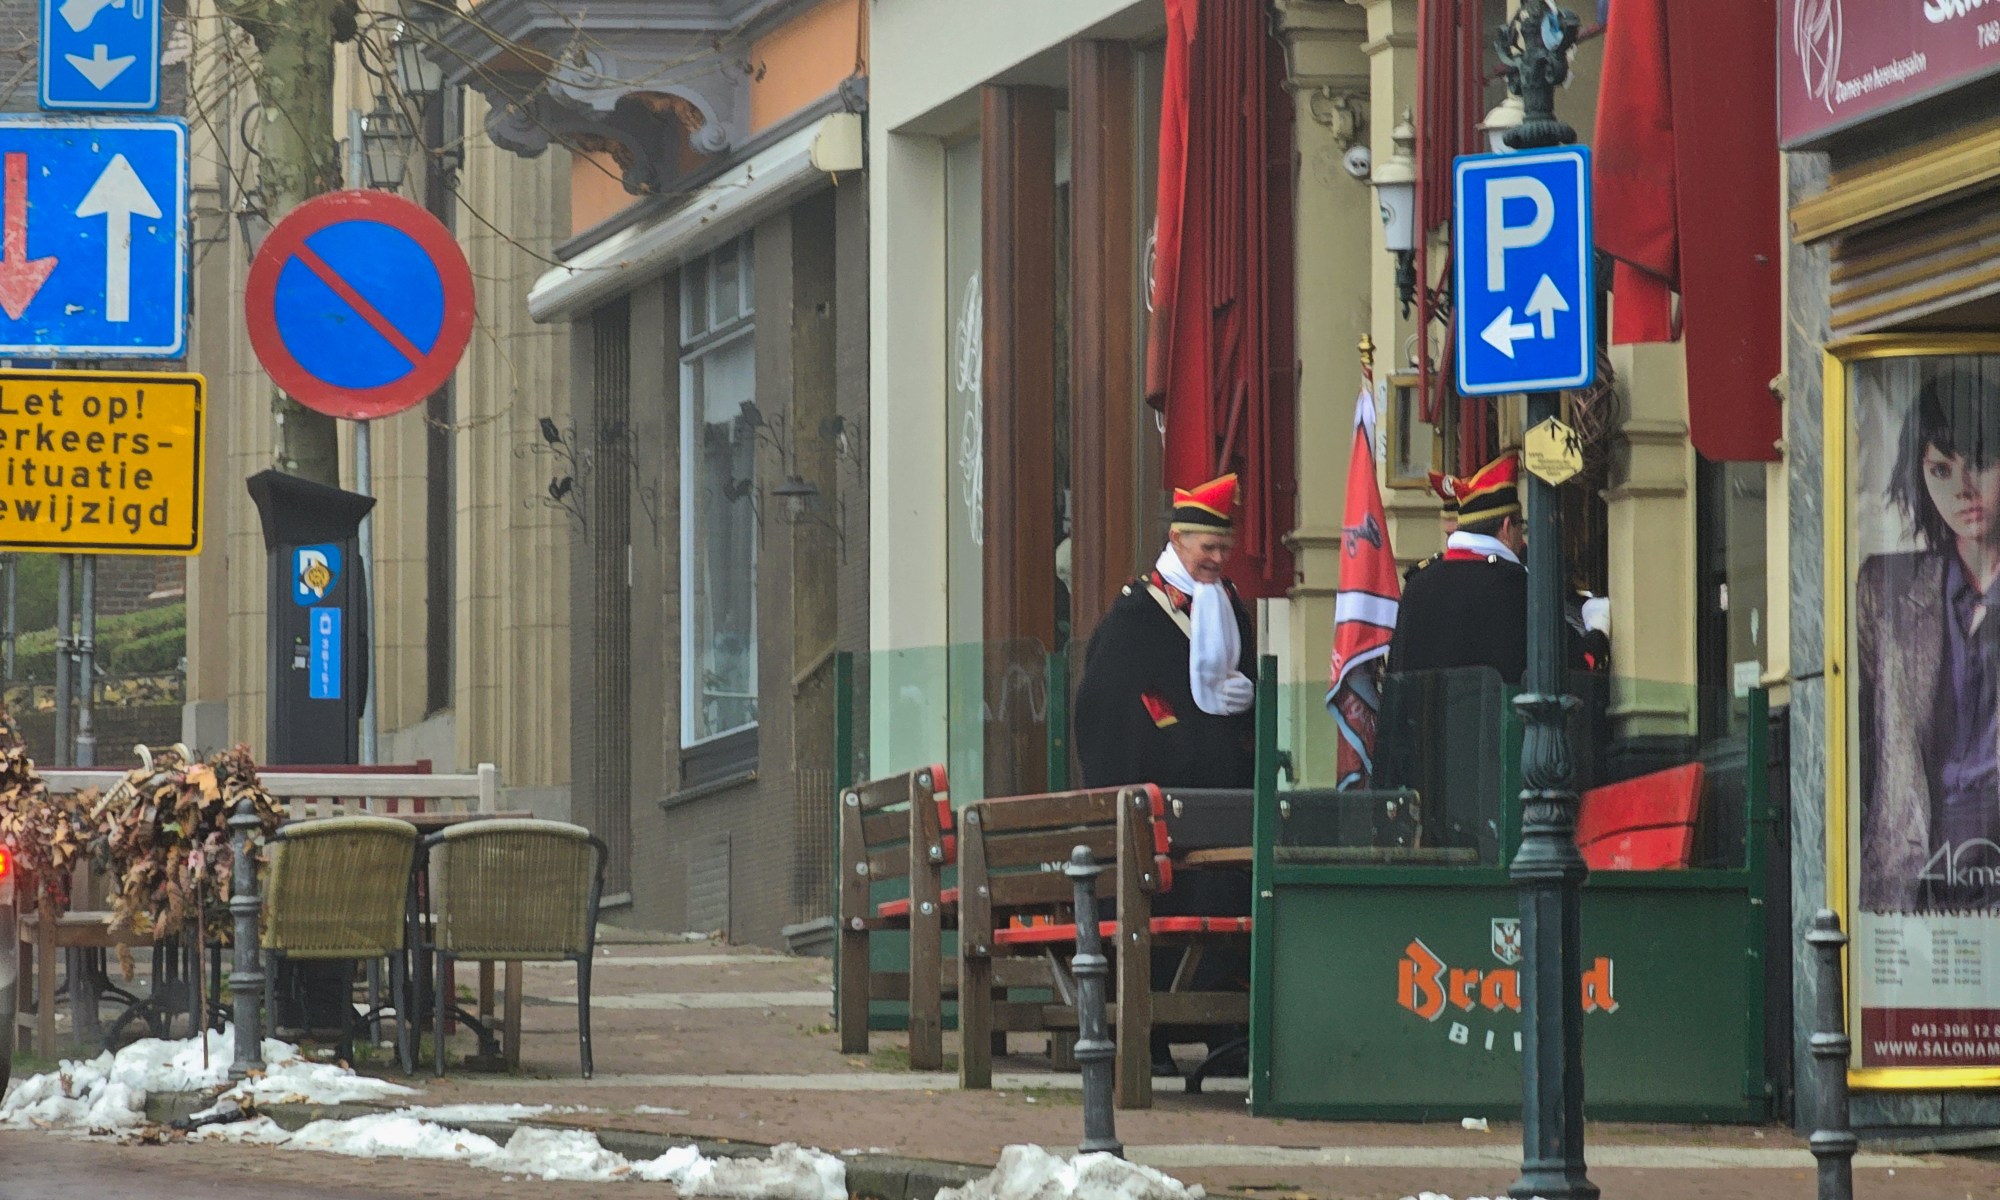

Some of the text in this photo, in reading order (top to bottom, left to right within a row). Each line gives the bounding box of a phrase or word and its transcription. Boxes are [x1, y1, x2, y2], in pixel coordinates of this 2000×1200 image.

[1486, 176, 1554, 292] P
[0, 386, 144, 424] Let op!
[1397, 937, 1619, 1022] Brad
